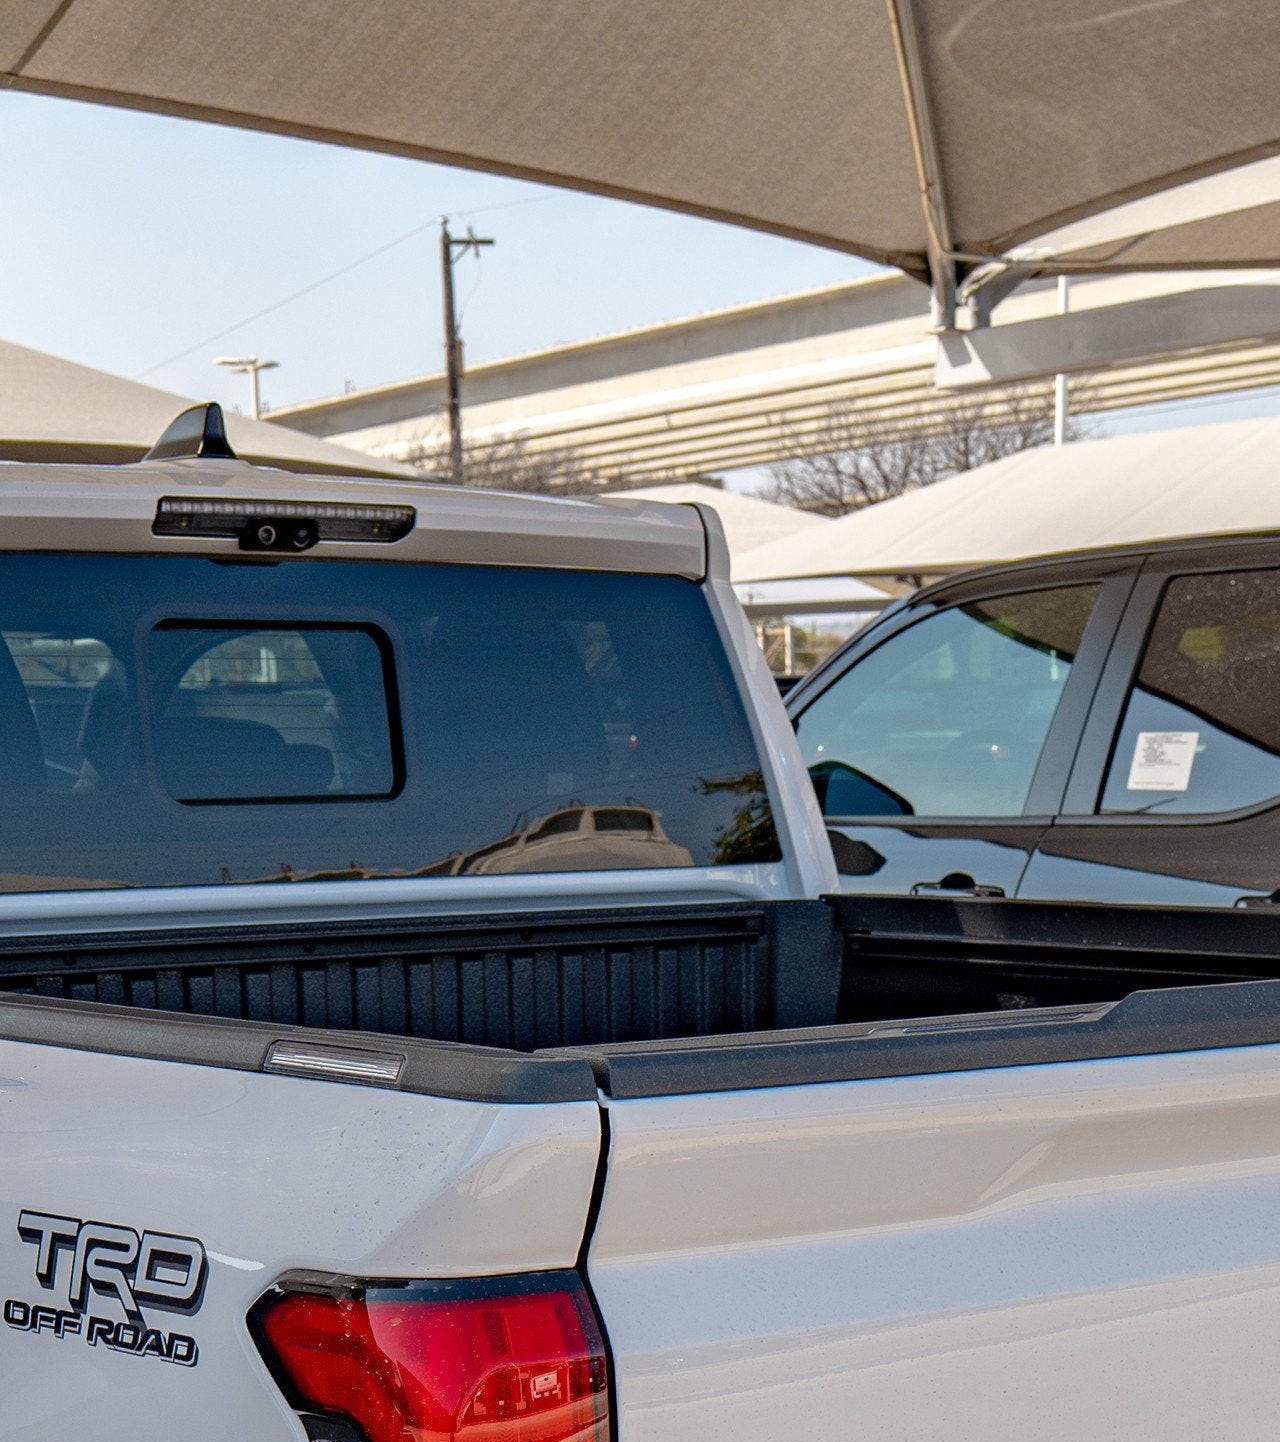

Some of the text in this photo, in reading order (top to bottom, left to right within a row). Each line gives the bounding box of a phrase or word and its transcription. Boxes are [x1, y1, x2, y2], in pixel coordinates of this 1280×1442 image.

[17, 1209, 209, 1324] TRD
[4, 1299, 199, 1367] OFF ROAD
